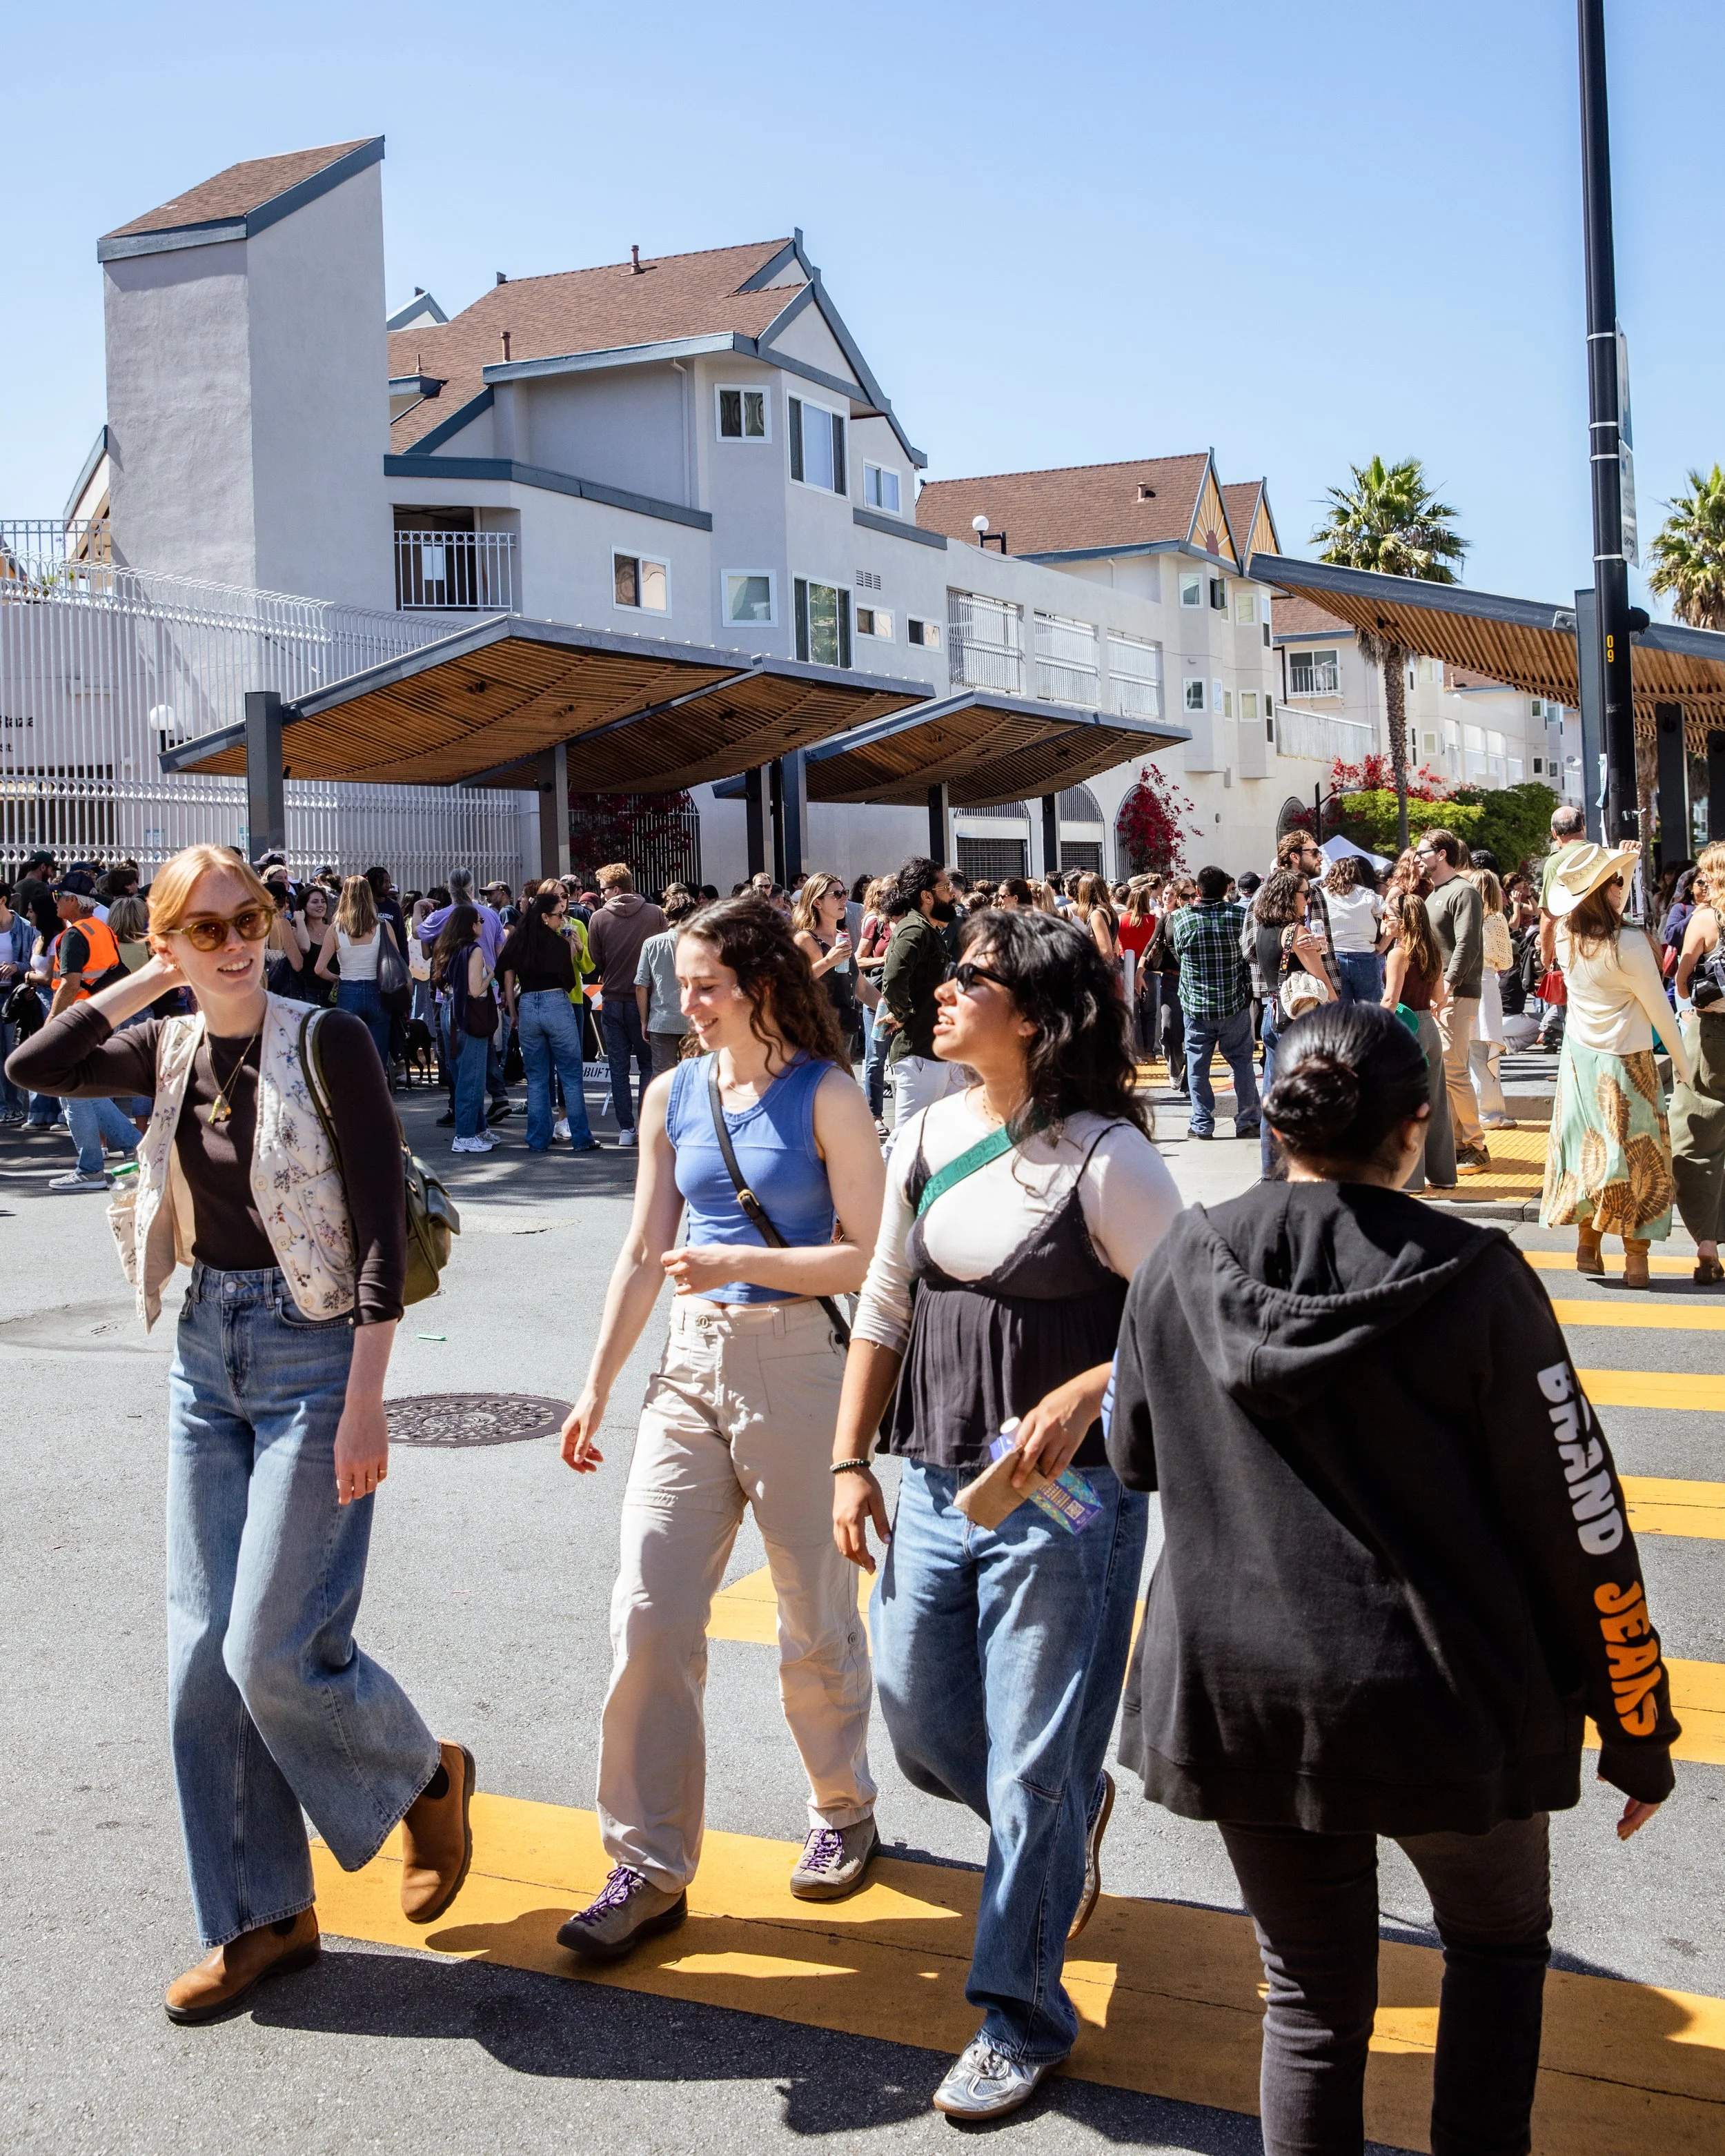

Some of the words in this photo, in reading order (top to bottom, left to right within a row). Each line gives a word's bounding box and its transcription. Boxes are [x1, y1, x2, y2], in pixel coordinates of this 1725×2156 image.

[1607, 635, 1614, 662] 09
[1537, 1360, 1624, 1555] BRAND
[1594, 1581, 1661, 1737] JEANS
